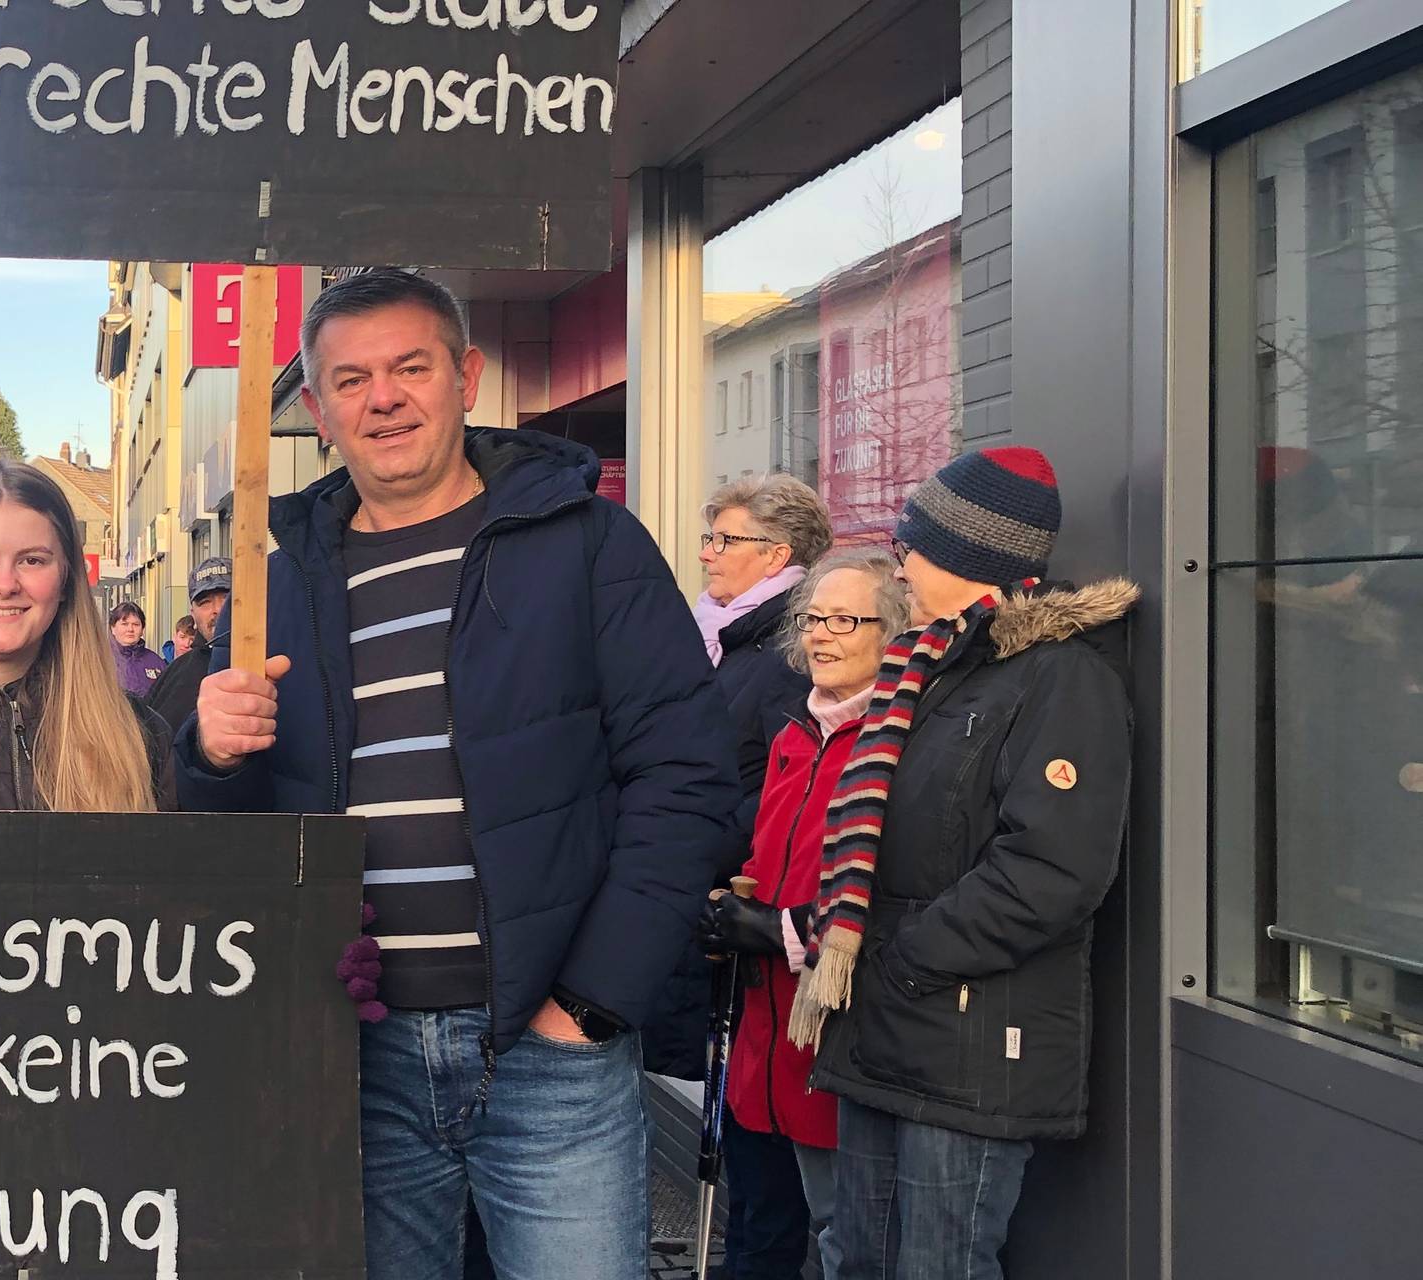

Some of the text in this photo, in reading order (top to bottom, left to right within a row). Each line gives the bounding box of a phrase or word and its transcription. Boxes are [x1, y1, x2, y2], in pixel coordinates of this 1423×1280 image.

[286, 38, 614, 138] Menschen
[834, 361, 895, 404] GLASFASER
[835, 404, 871, 439] FÜR DIE
[834, 439, 881, 474] ZUKUNFT
